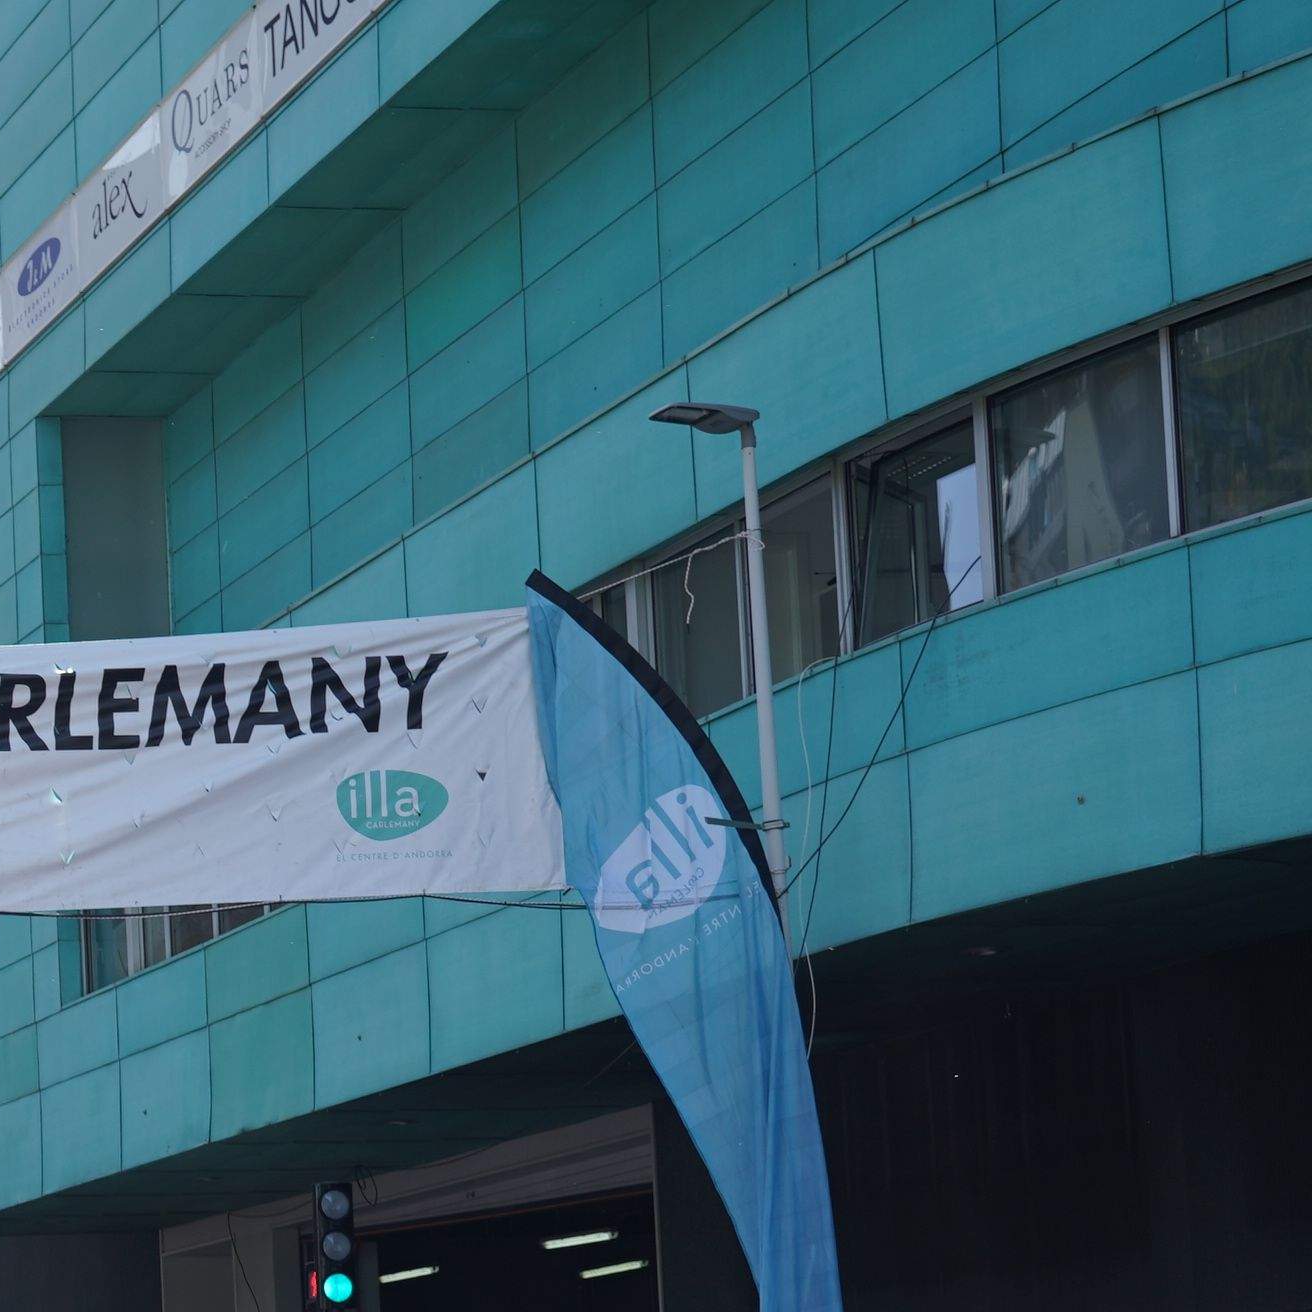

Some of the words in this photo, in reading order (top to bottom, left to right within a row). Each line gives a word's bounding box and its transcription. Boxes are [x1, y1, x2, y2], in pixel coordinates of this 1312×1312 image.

[172, 48, 250, 153] QUARS
[348, 769, 422, 819] illa
[366, 820, 420, 830] CARLEMANY
[336, 854, 346, 863] EL
[351, 852, 392, 862] CENTRE
